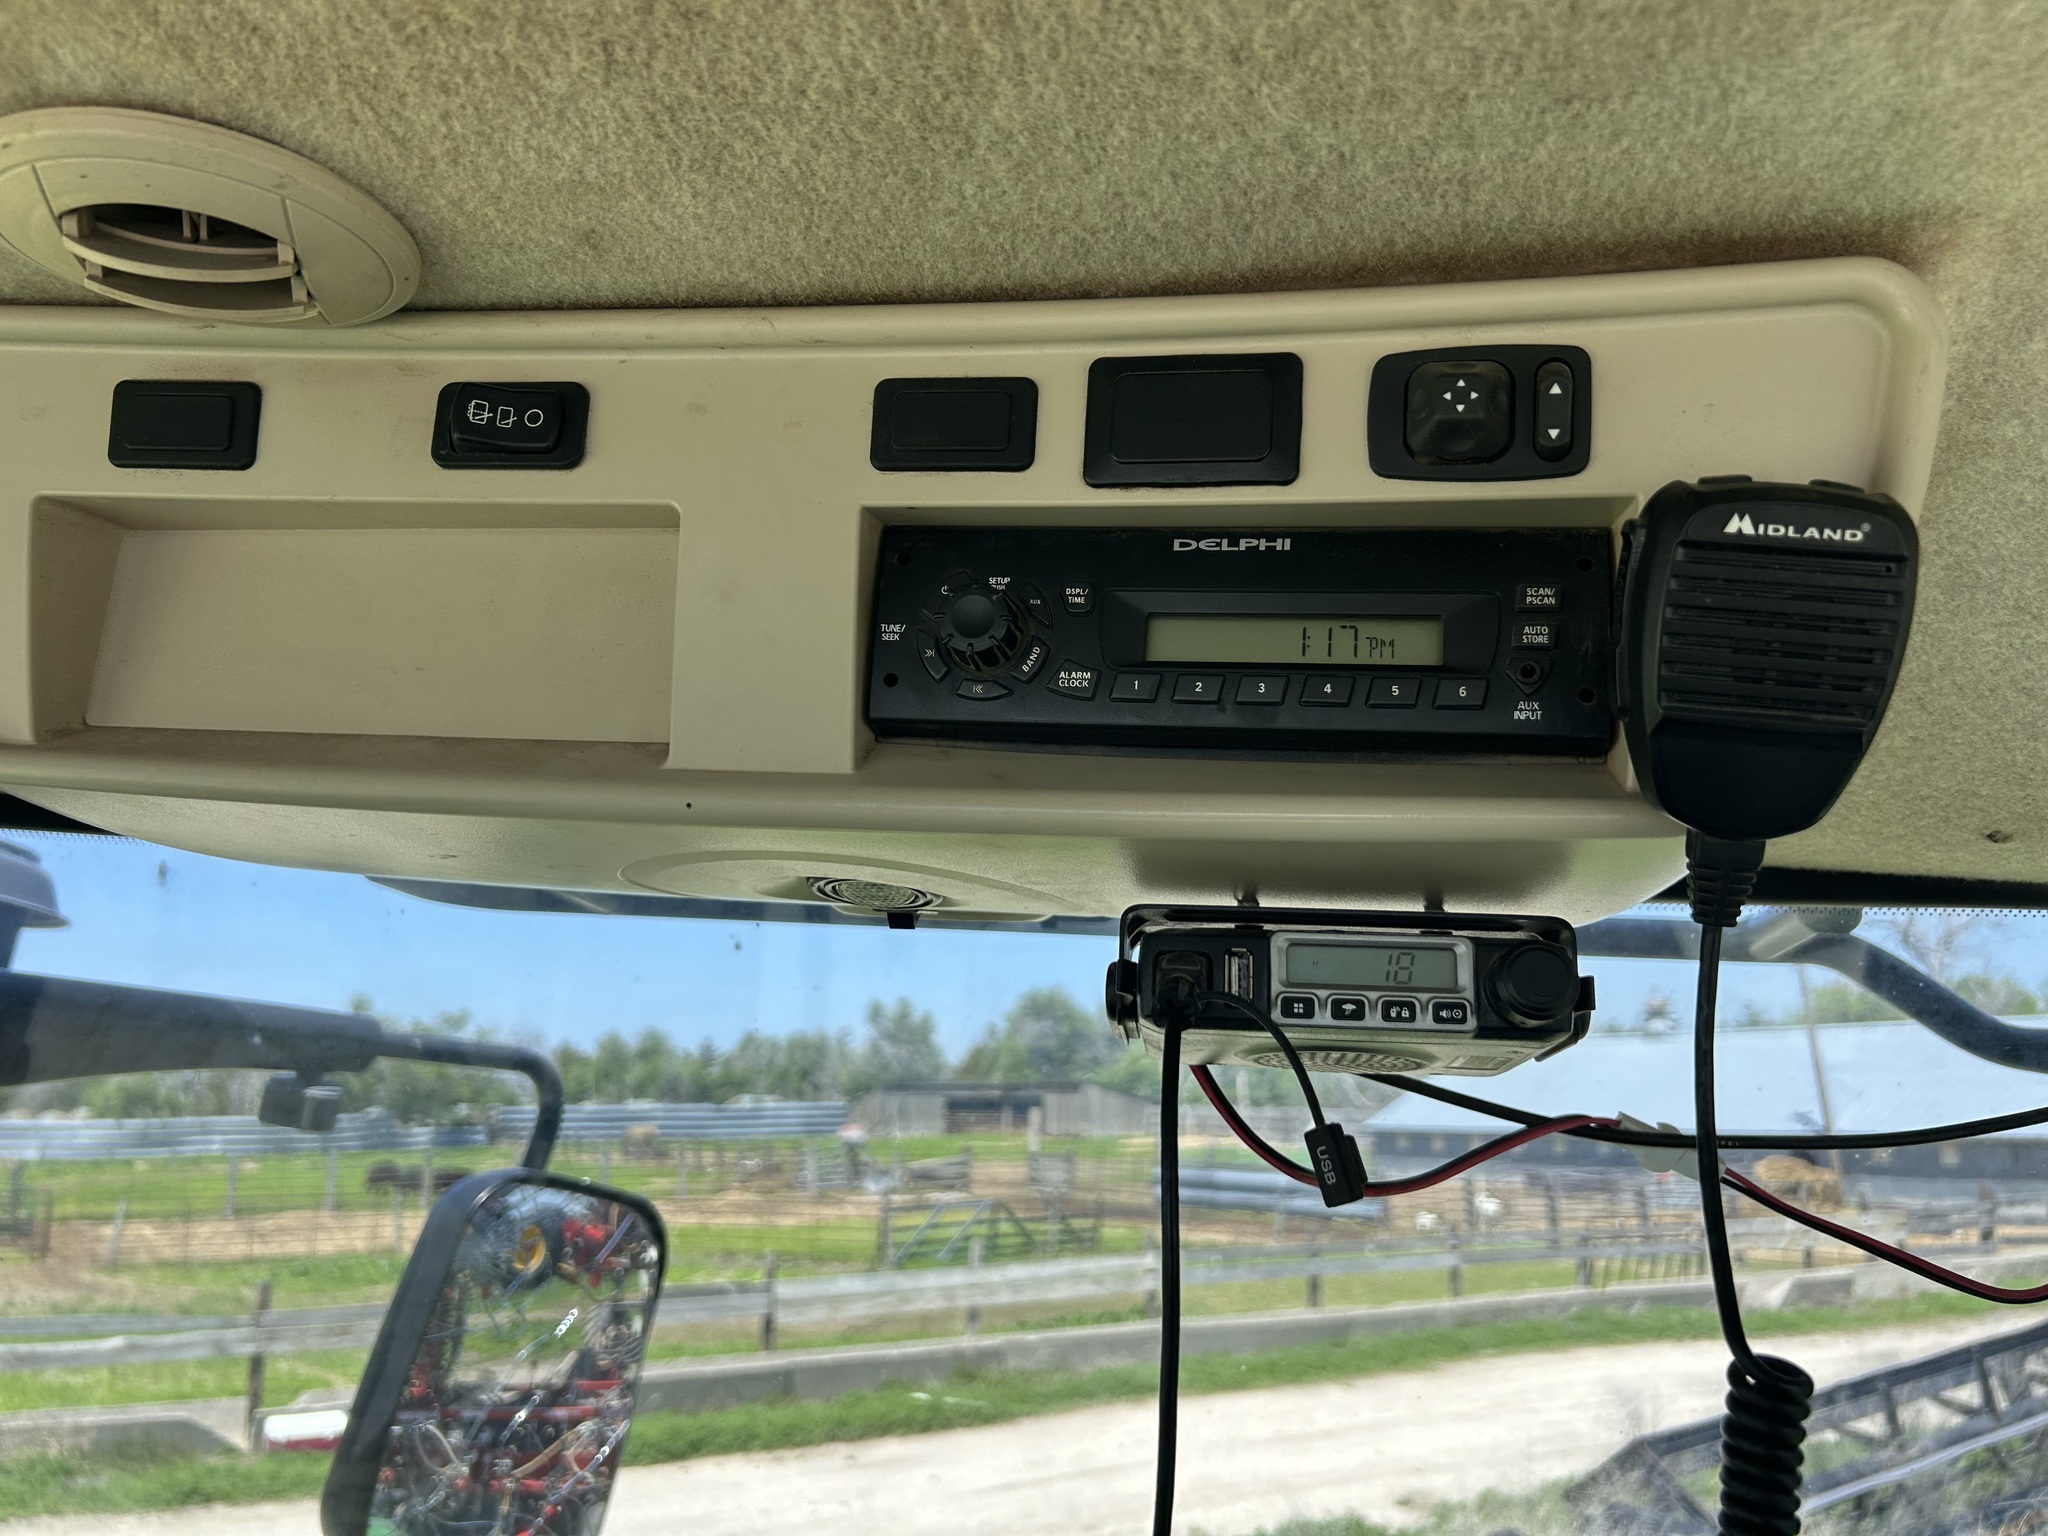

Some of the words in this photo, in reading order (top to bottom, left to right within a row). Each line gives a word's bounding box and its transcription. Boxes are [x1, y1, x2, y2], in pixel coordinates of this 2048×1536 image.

[1172, 538, 1292, 551] DELPHI
[988, 576, 1011, 585] SETUP
[1065, 587, 1089, 596] DSPL/
[1525, 587, 1556, 596] SCAN/
[1067, 596, 1086, 604] TIME
[1525, 596, 1556, 605] PSCAN
[880, 623, 907, 633] TUNE/
[1522, 625, 1549, 635] AUTO
[881, 632, 901, 641] SEEK
[1301, 624, 1359, 658] 1:17
[1365, 636, 1395, 659] PM
[1522, 634, 1549, 644] STORE
[1021, 645, 1041, 673] BAND
[1058, 671, 1091, 681] ALARM
[1058, 678, 1090, 688] CLOCK
[1133, 680, 1139, 690] 1
[1194, 682, 1203, 692] 2
[1257, 682, 1265, 693] 3
[1323, 683, 1332, 694] 4
[1391, 685, 1400, 696] 5
[1458, 686, 1467, 697] 6
[1517, 701, 1540, 710] AUX
[1513, 710, 1542, 720] INPUT
[1384, 951, 1416, 985] 18
[1316, 1144, 1337, 1186] USB
